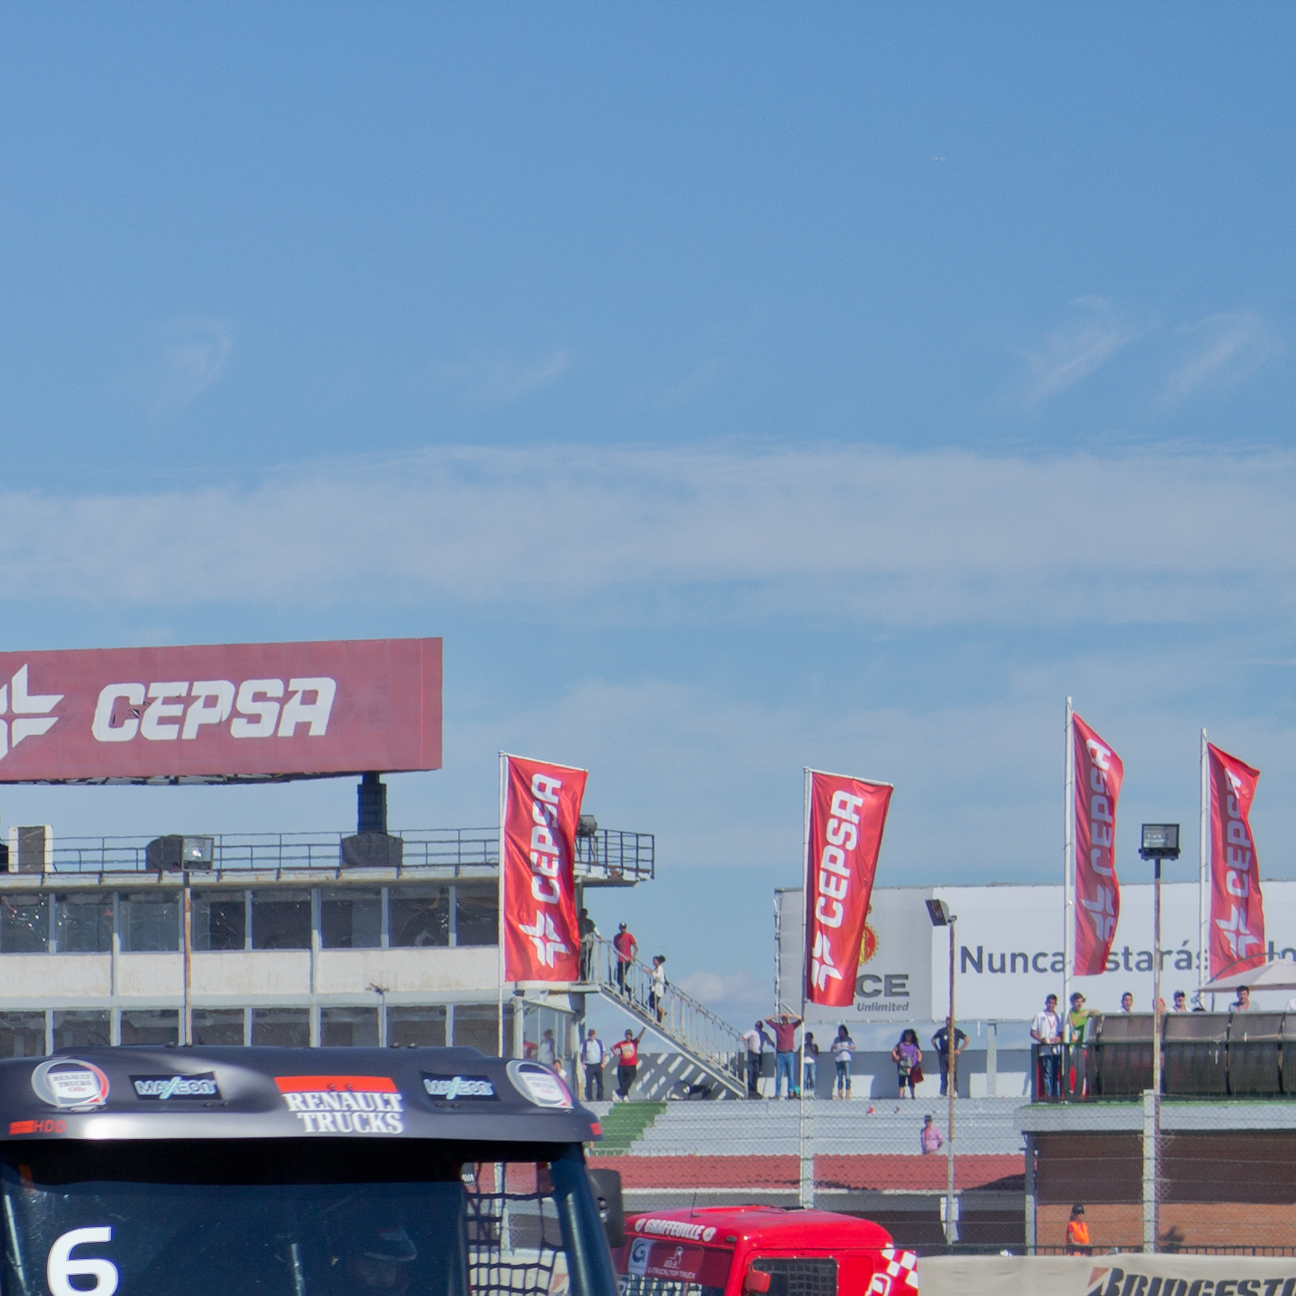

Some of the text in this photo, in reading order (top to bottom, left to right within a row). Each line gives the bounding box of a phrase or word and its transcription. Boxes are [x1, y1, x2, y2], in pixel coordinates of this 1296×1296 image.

[91, 675, 338, 743] CEPSA
[1084, 738, 1113, 876] CEPSA
[530, 772, 562, 905] CEPSA
[814, 789, 864, 928] CEPSA
[960, 940, 1209, 973] Nunca starás
[854, 973, 910, 998] CE
[856, 1000, 910, 1013] Unlimited
[281, 1091, 404, 1114] RENAULT
[296, 1111, 406, 1135] TRUCKS
